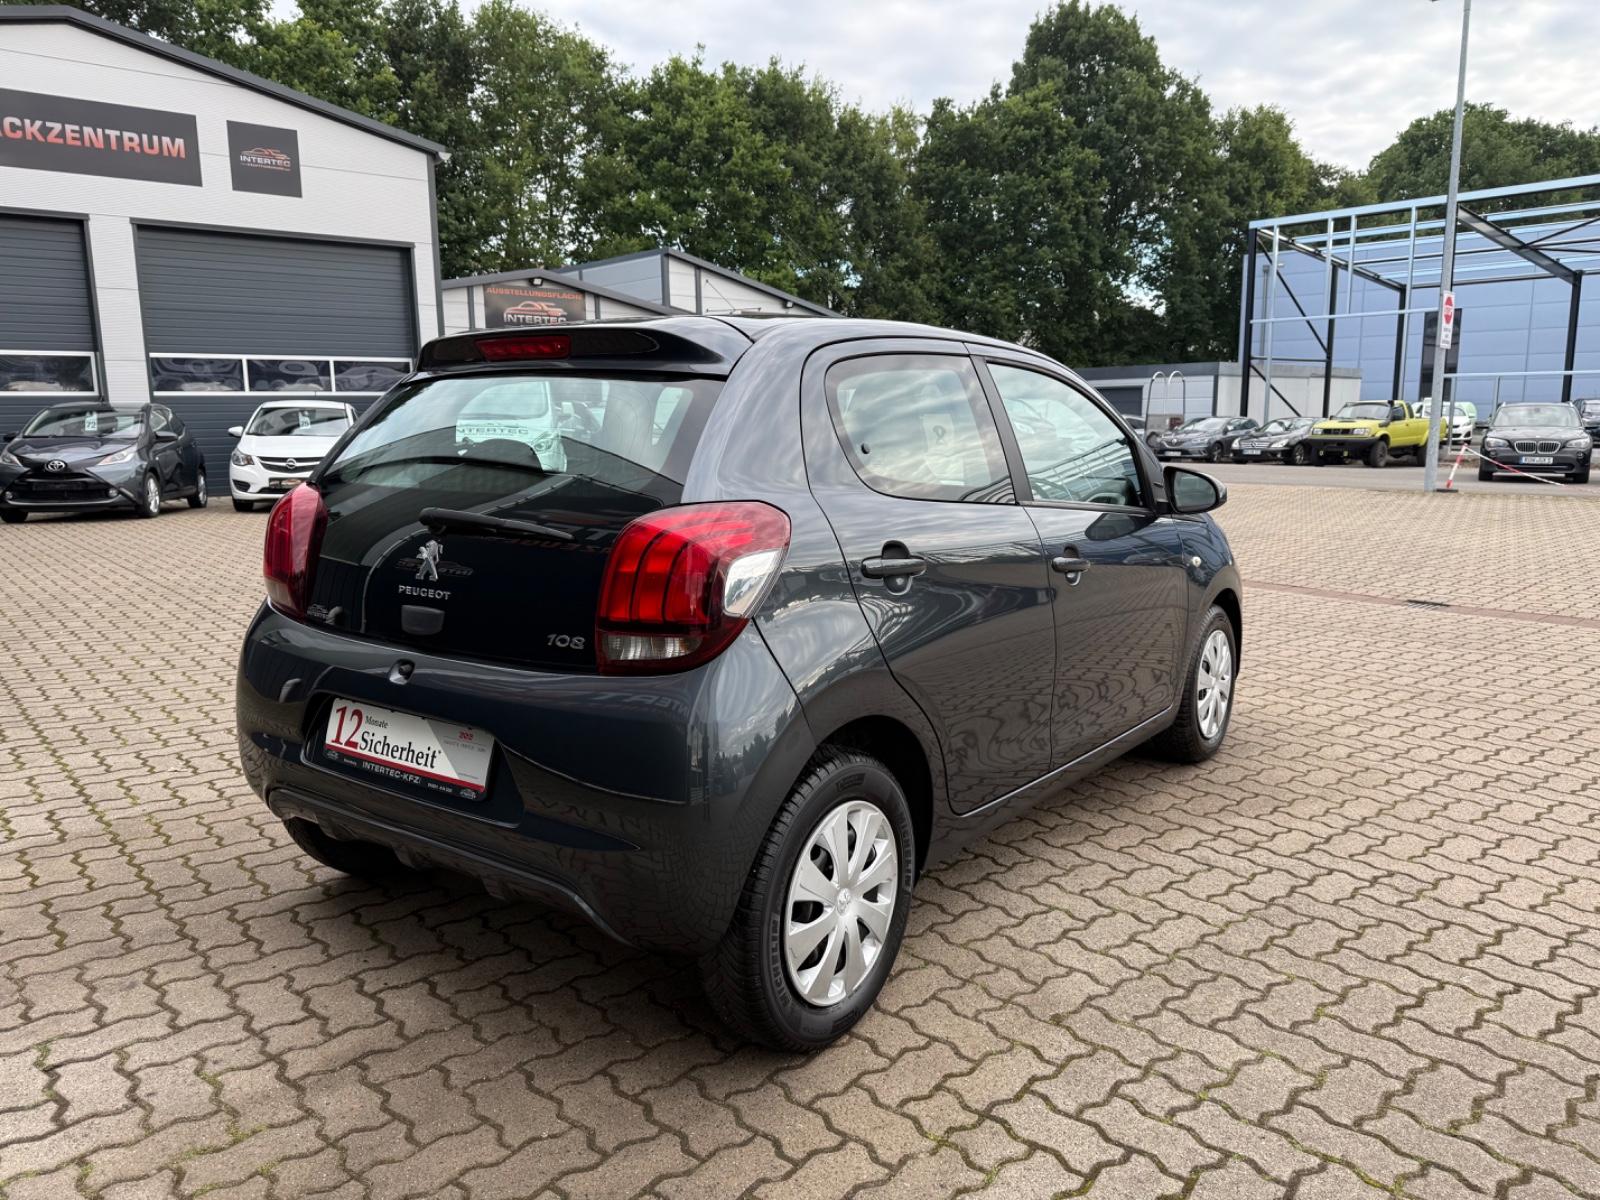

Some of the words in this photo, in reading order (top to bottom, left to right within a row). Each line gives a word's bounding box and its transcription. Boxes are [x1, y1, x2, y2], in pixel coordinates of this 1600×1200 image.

[0, 115, 187, 159] CKZENTRUM
[398, 585, 451, 600] PEUGEOT
[547, 633, 586, 650] 108
[331, 705, 364, 750] 12
[365, 715, 389, 729] Monate
